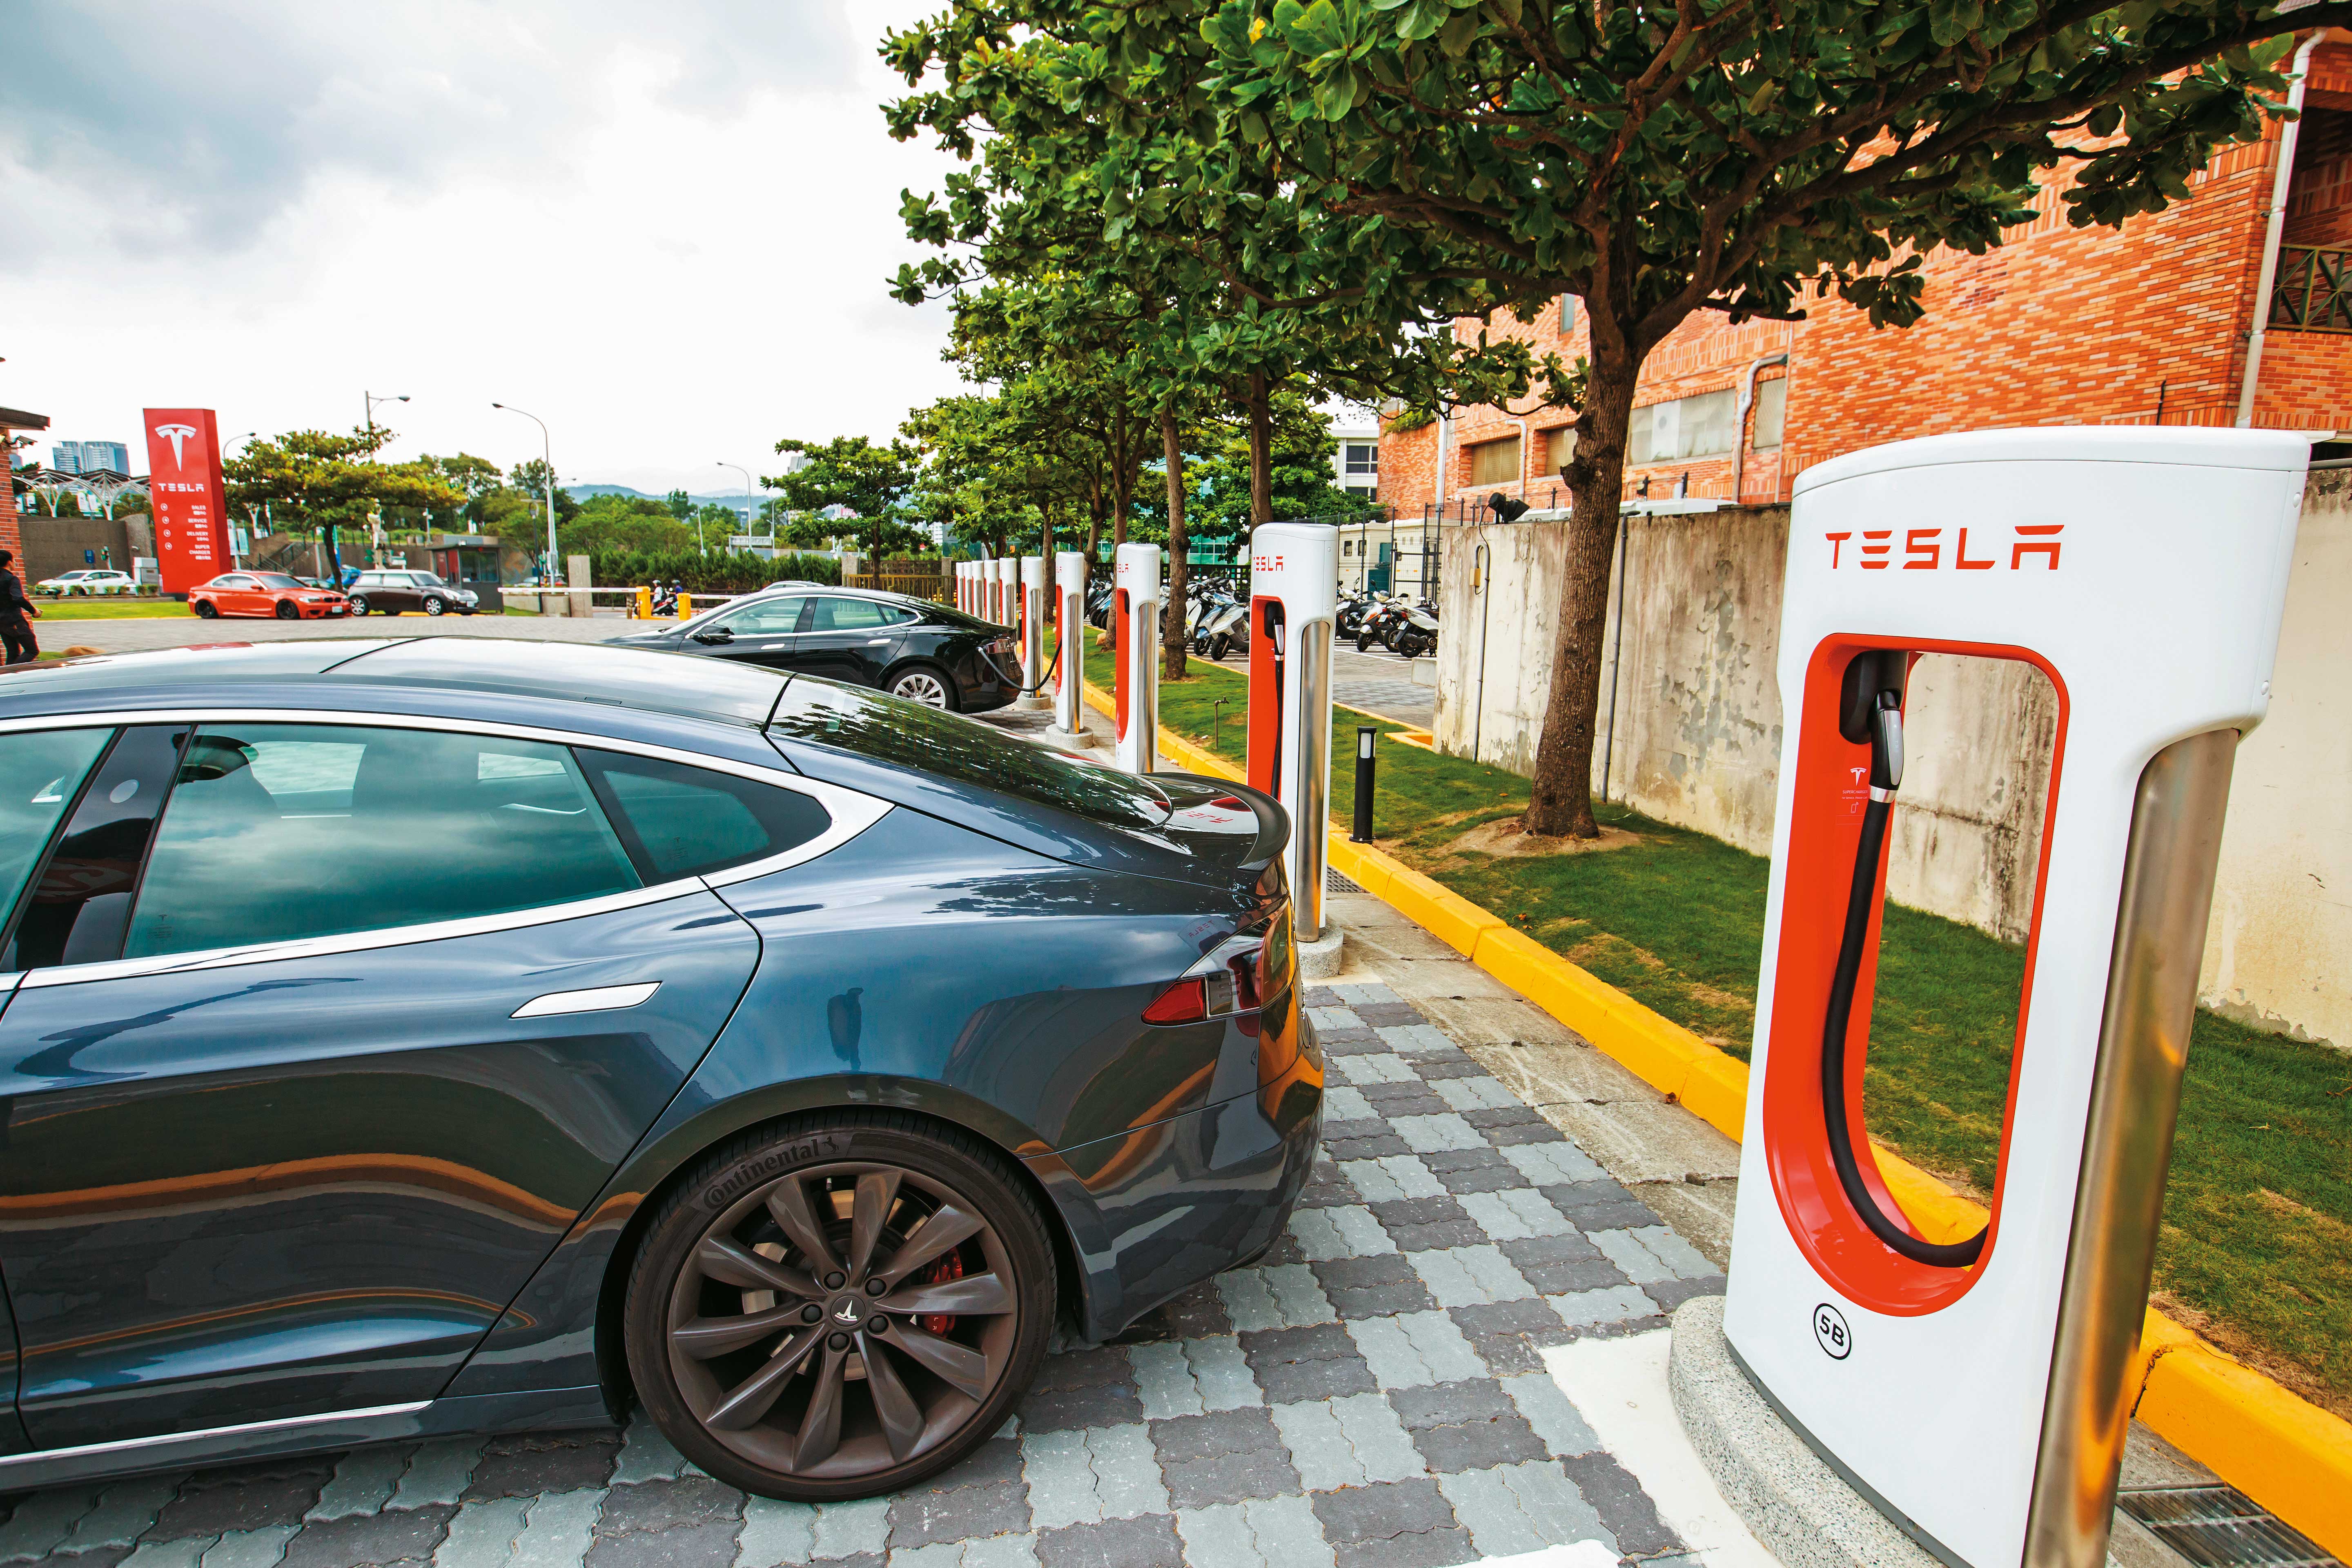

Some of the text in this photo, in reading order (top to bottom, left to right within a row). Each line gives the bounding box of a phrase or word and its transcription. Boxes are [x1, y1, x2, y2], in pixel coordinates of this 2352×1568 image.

[158, 483, 205, 492] TESLA
[1826, 525, 2064, 570] TESLA
[703, 1138, 820, 1209] Continental
[1819, 1313, 1844, 1347] 5B
